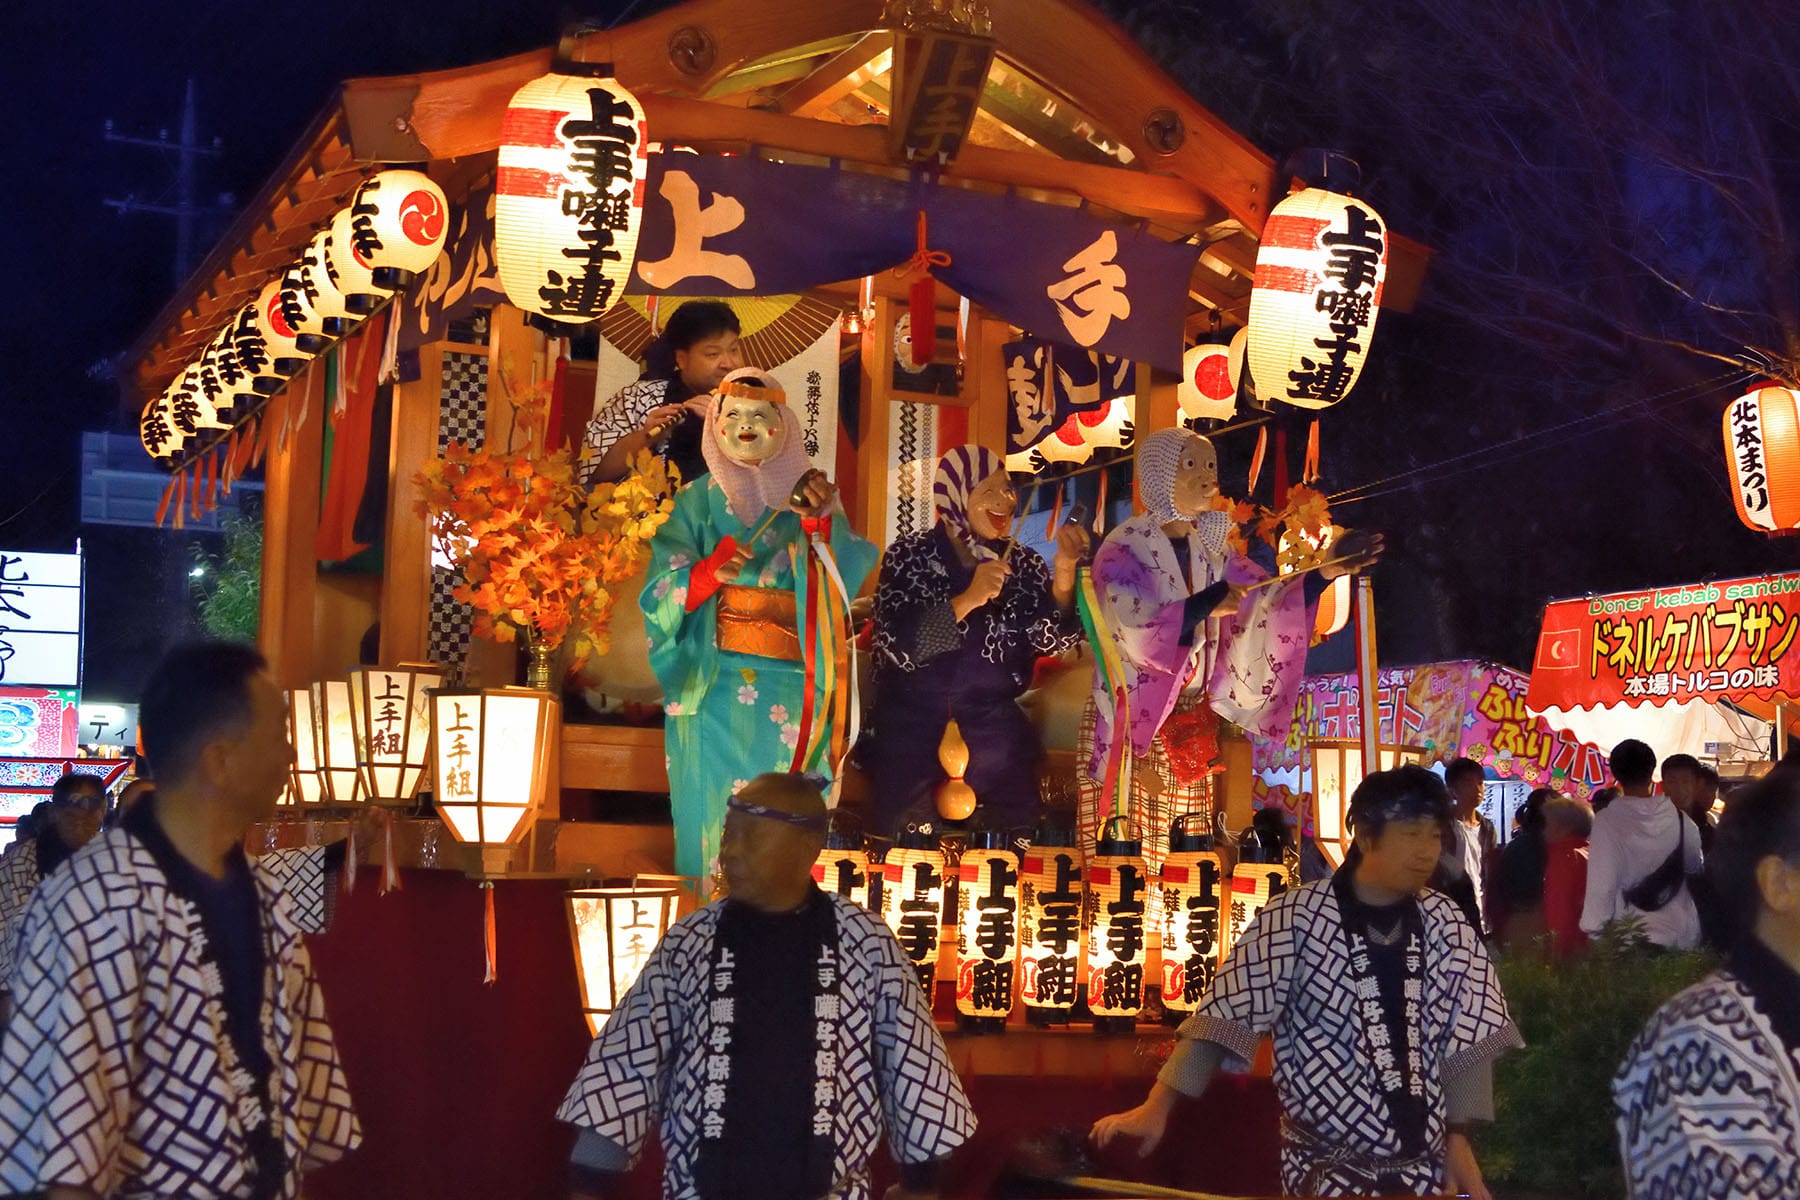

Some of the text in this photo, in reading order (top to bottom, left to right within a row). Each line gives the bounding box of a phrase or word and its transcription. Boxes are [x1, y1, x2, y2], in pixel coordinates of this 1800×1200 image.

[538, 87, 637, 318] 上手囃子連
[1286, 204, 1383, 404] 上手囃子連
[1732, 401, 1769, 512] 北本まつり
[1588, 596, 1649, 616] Doner
[1654, 585, 1720, 609] kebab
[372, 674, 405, 757] 上手組
[1623, 663, 1780, 697] 本場トルコの味
[445, 702, 474, 797] 上手組
[975, 857, 1018, 1011] 上手組
[1036, 853, 1083, 1006] 上手組
[1103, 864, 1146, 1011] 上手組
